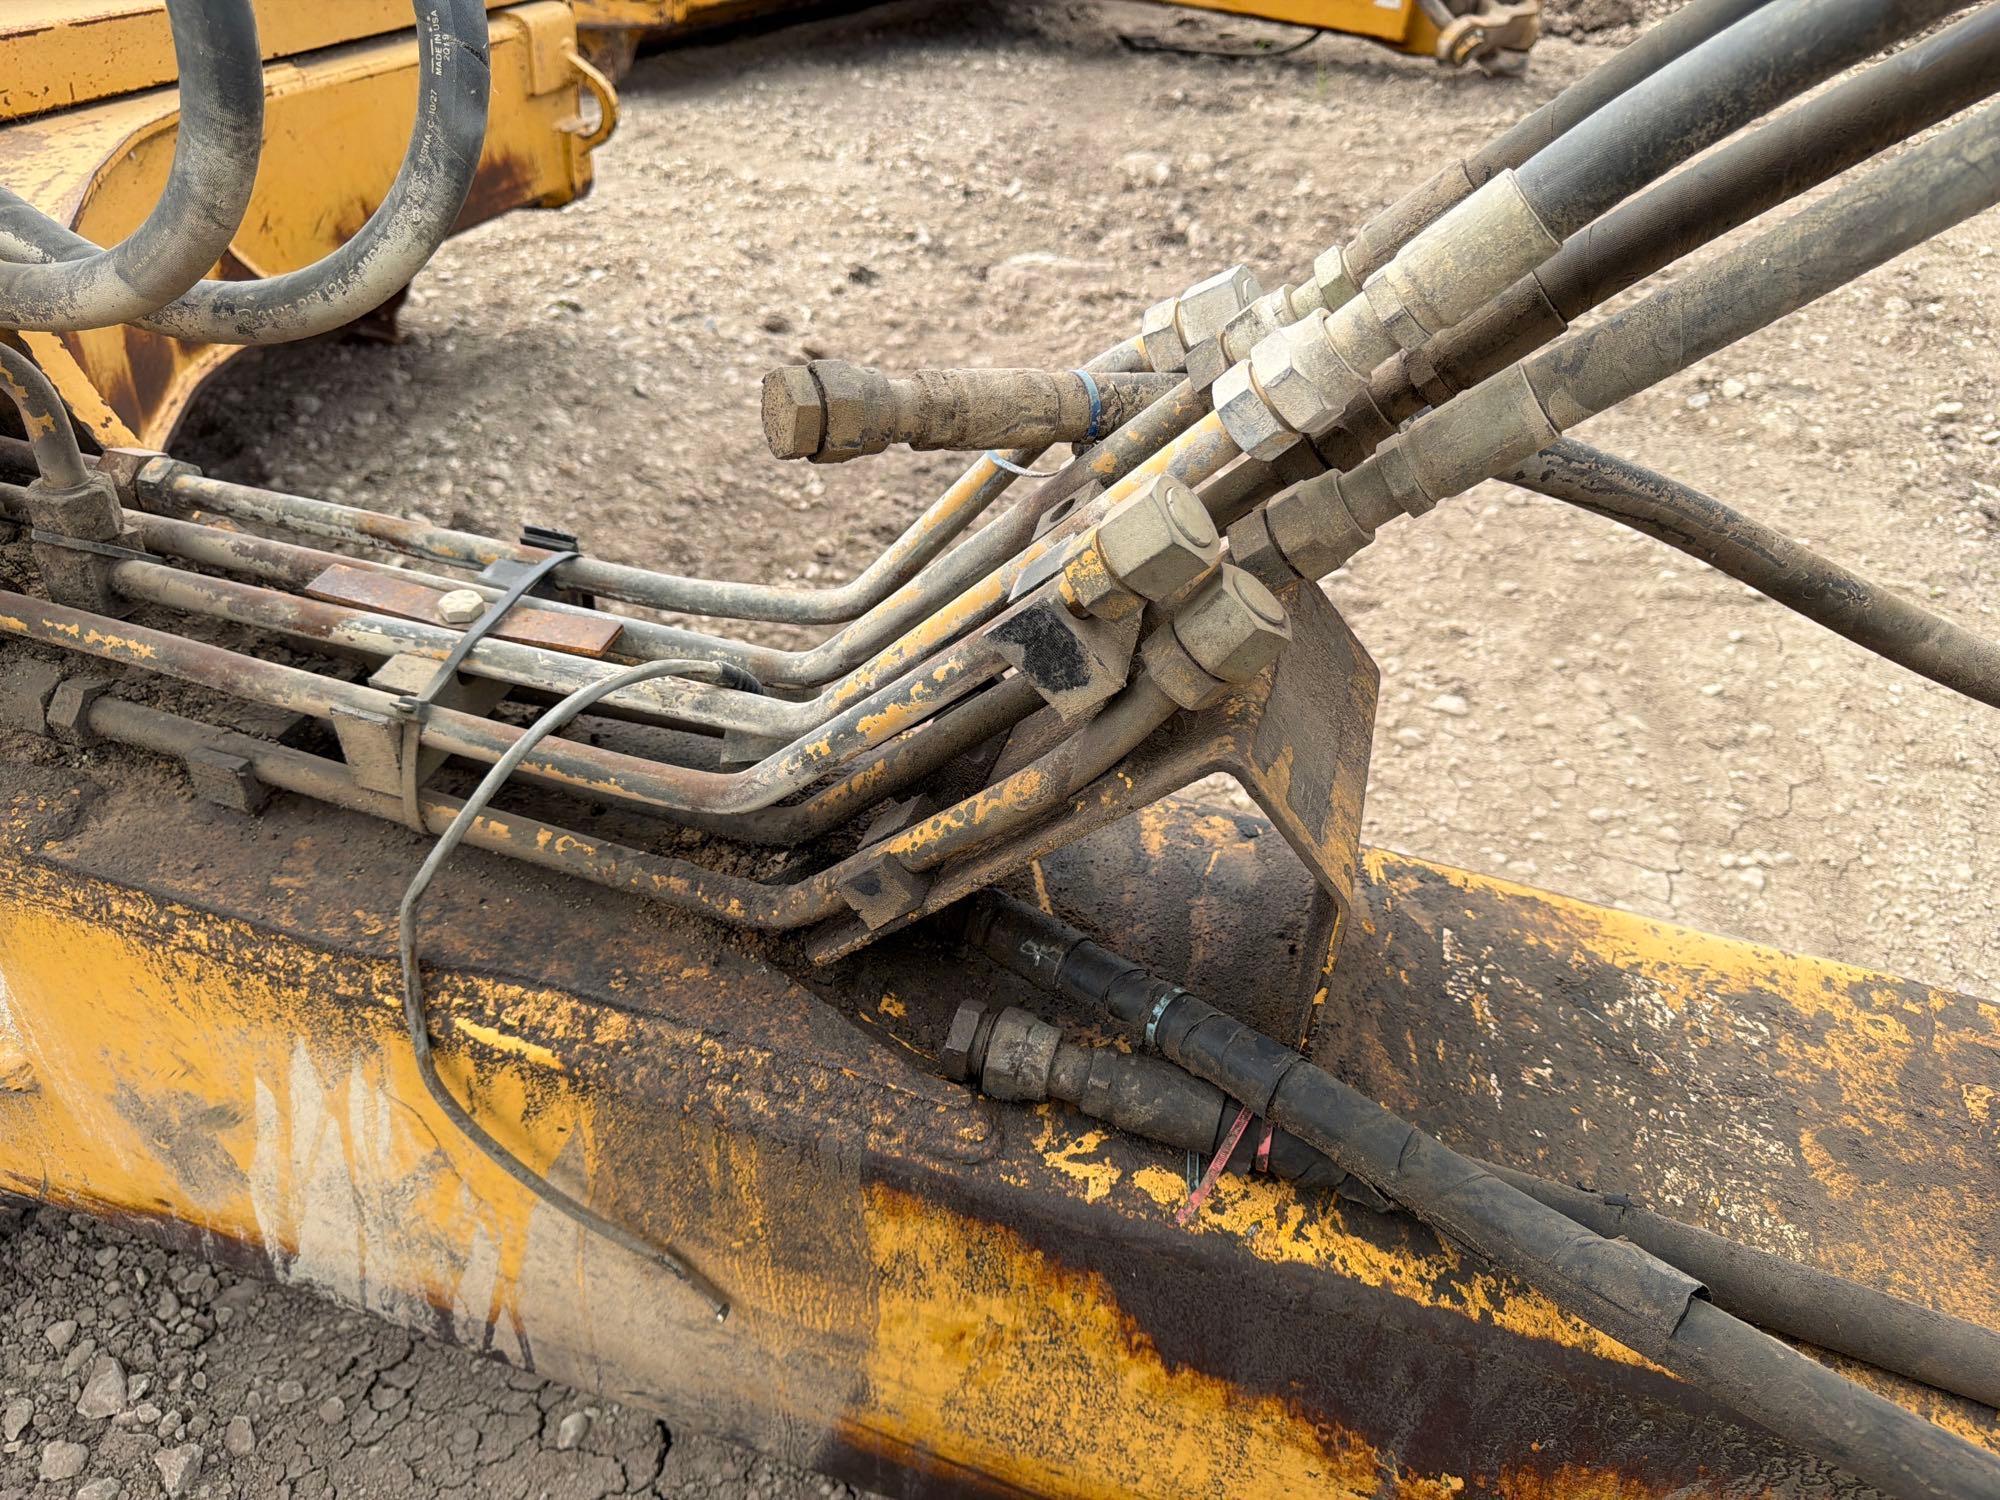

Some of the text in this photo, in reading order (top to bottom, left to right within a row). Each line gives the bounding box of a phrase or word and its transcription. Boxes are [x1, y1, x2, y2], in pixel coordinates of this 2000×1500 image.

[430, 9, 443, 76] MADE IN USA
